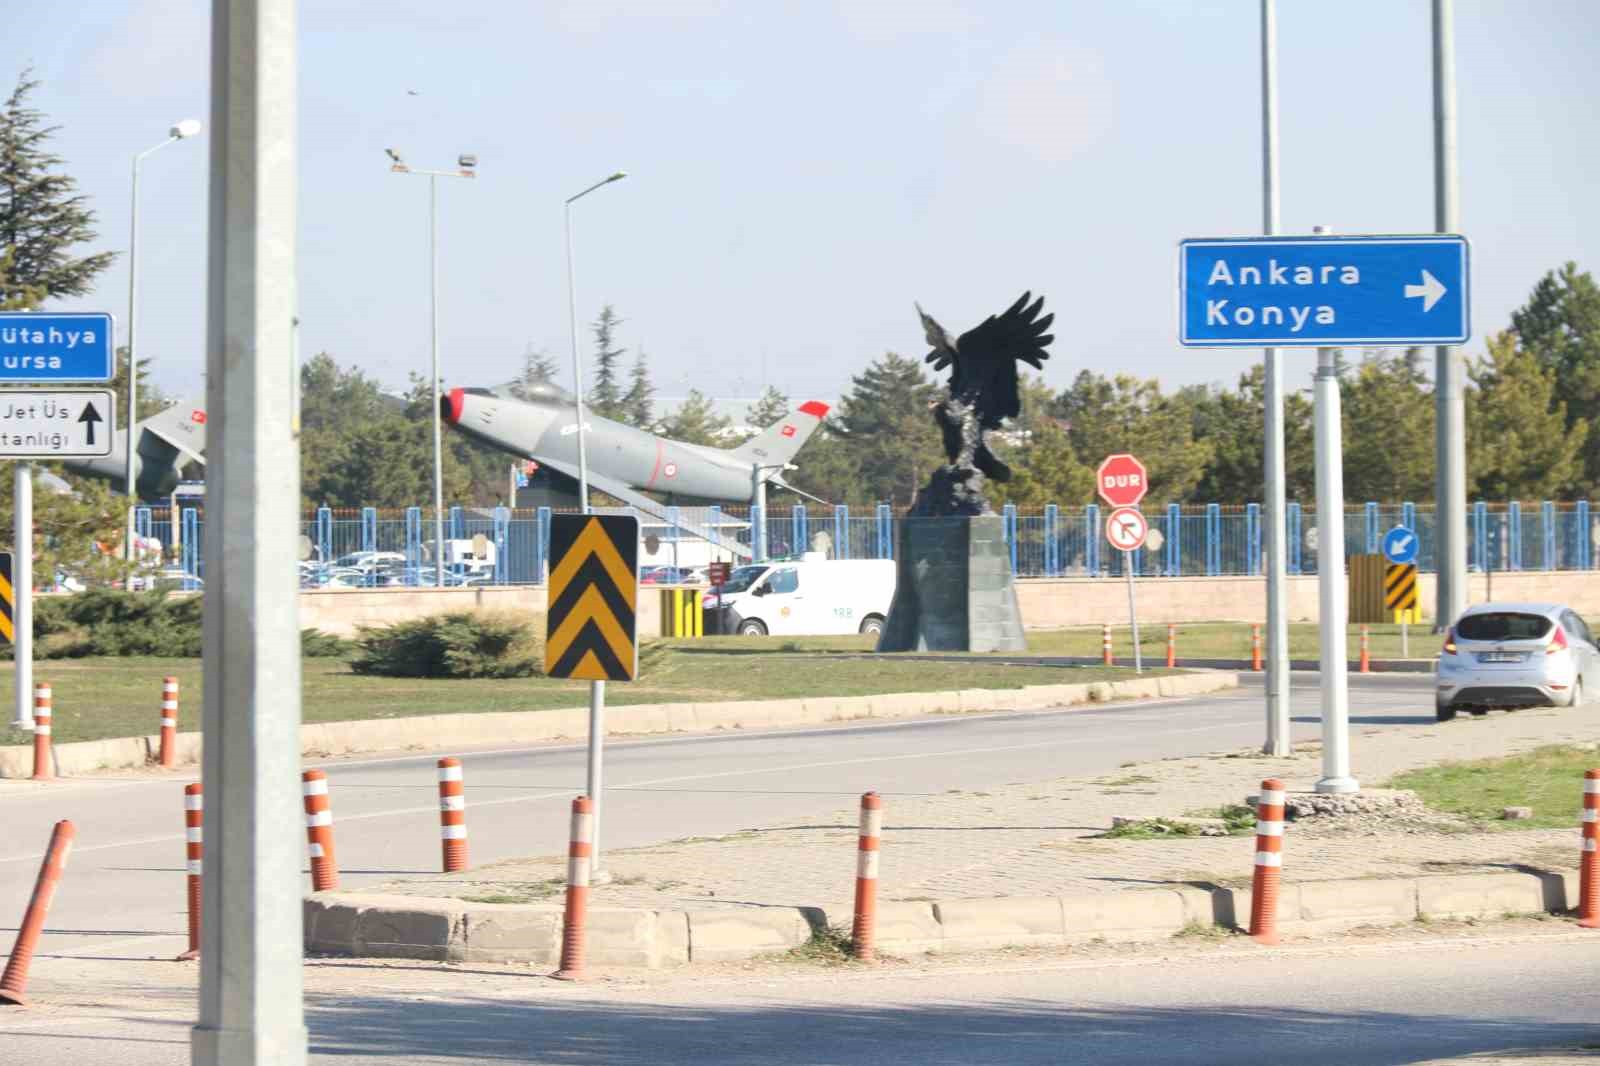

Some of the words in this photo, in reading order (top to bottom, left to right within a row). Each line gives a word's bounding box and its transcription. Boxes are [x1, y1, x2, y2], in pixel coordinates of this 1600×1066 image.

[1208, 259, 1361, 286] Ankara
[1206, 298, 1336, 333] Konya
[0, 326, 96, 348] ütahya
[3, 355, 62, 369] ursa
[3, 404, 35, 419] Jet
[43, 400, 69, 419] Üs
[1, 431, 70, 449] tanlığı
[1103, 473, 1141, 489] DUR
